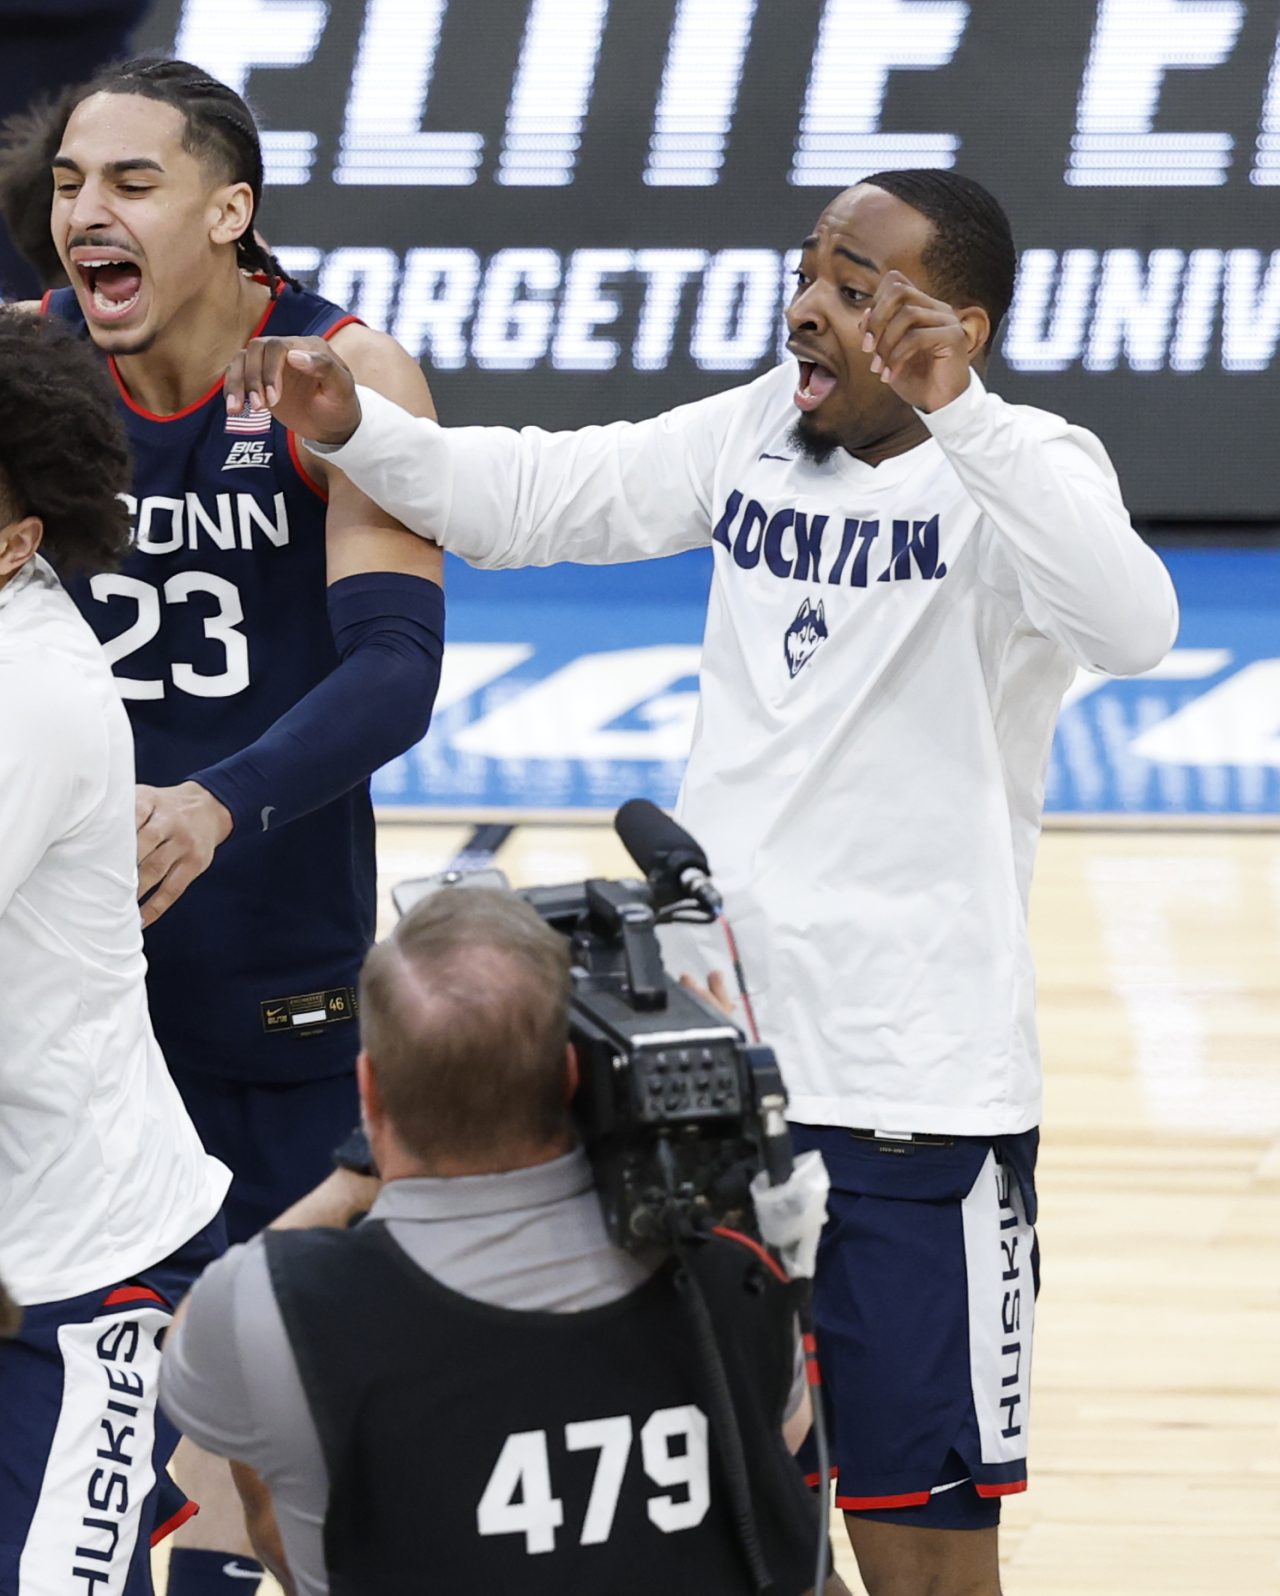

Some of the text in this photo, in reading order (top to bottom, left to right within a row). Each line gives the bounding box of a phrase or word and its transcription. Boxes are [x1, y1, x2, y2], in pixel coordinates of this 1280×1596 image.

[270, 246, 803, 370] ORGETO
[225, 453, 273, 464] EAST
[230, 441, 266, 453] BIG
[114, 491, 289, 555] ONN
[712, 489, 829, 584] LOCK
[828, 517, 879, 588] IT
[89, 570, 250, 700] 23
[329, 997, 344, 1011] 46
[995, 1171, 1022, 1440] HUSKIE
[477, 1404, 710, 1555] 479
